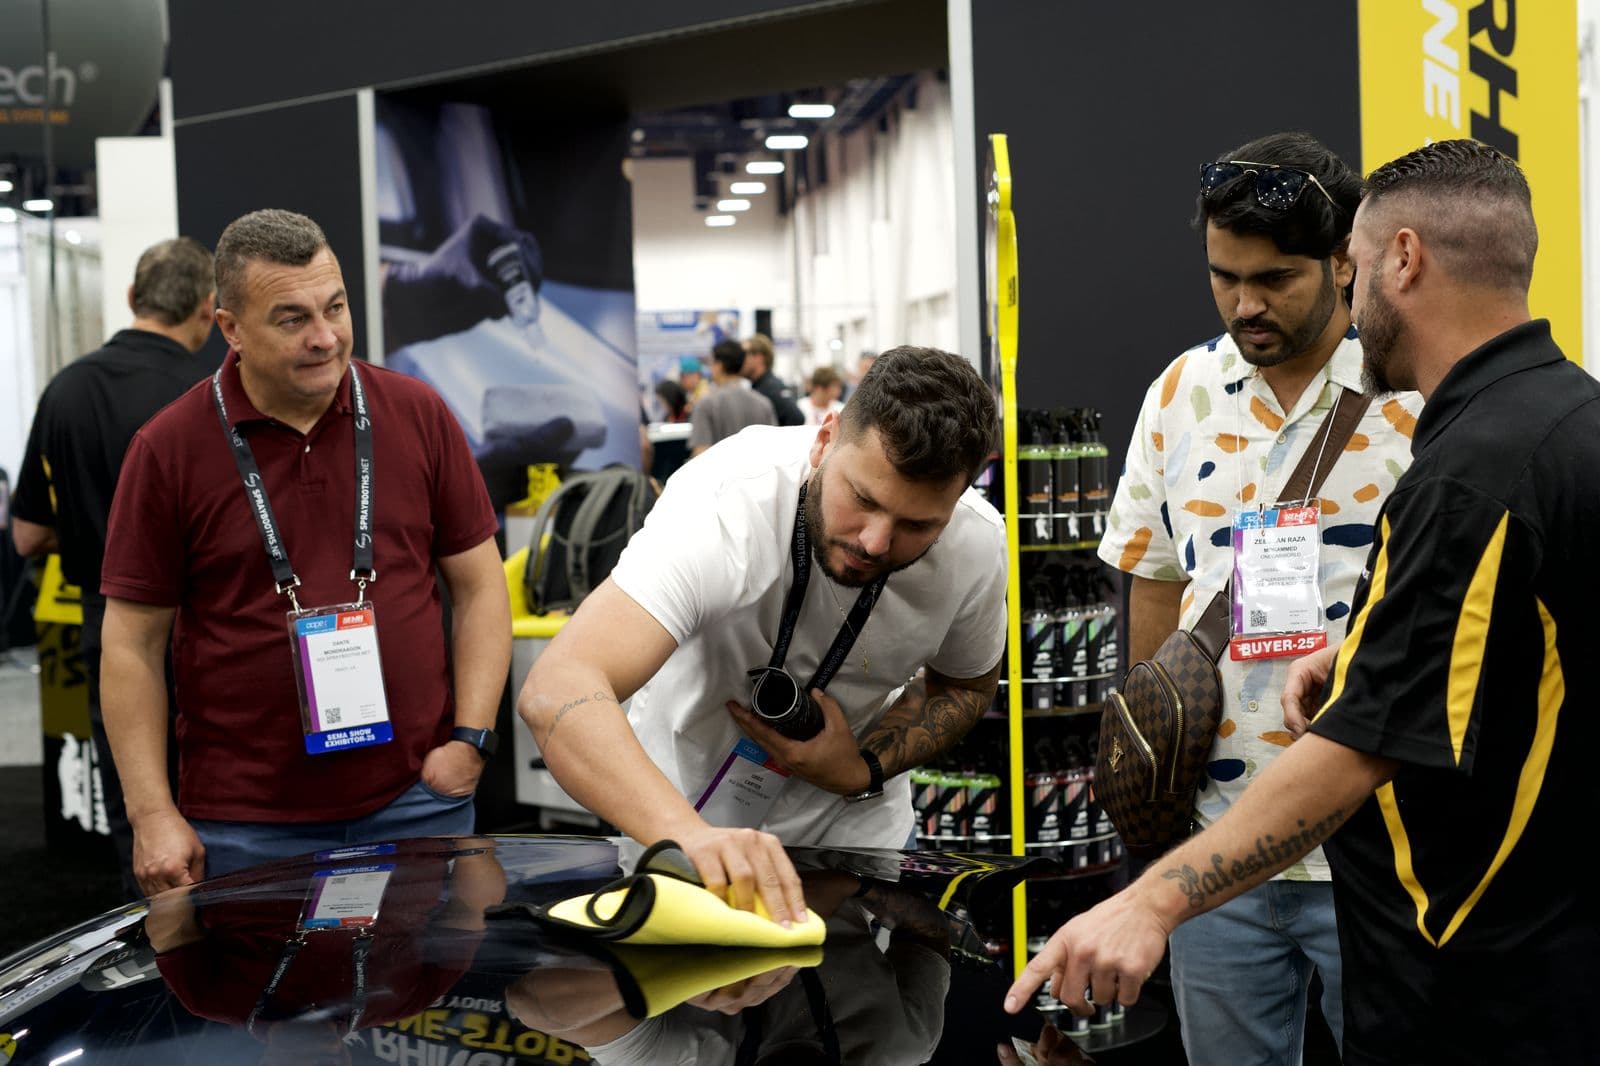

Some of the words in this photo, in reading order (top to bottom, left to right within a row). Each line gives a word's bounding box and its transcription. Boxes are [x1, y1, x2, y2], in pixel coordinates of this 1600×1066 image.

[1241, 637, 1315, 657] BUYER-25
[326, 731, 348, 741] SEMA
[349, 727, 372, 737] SHOW
